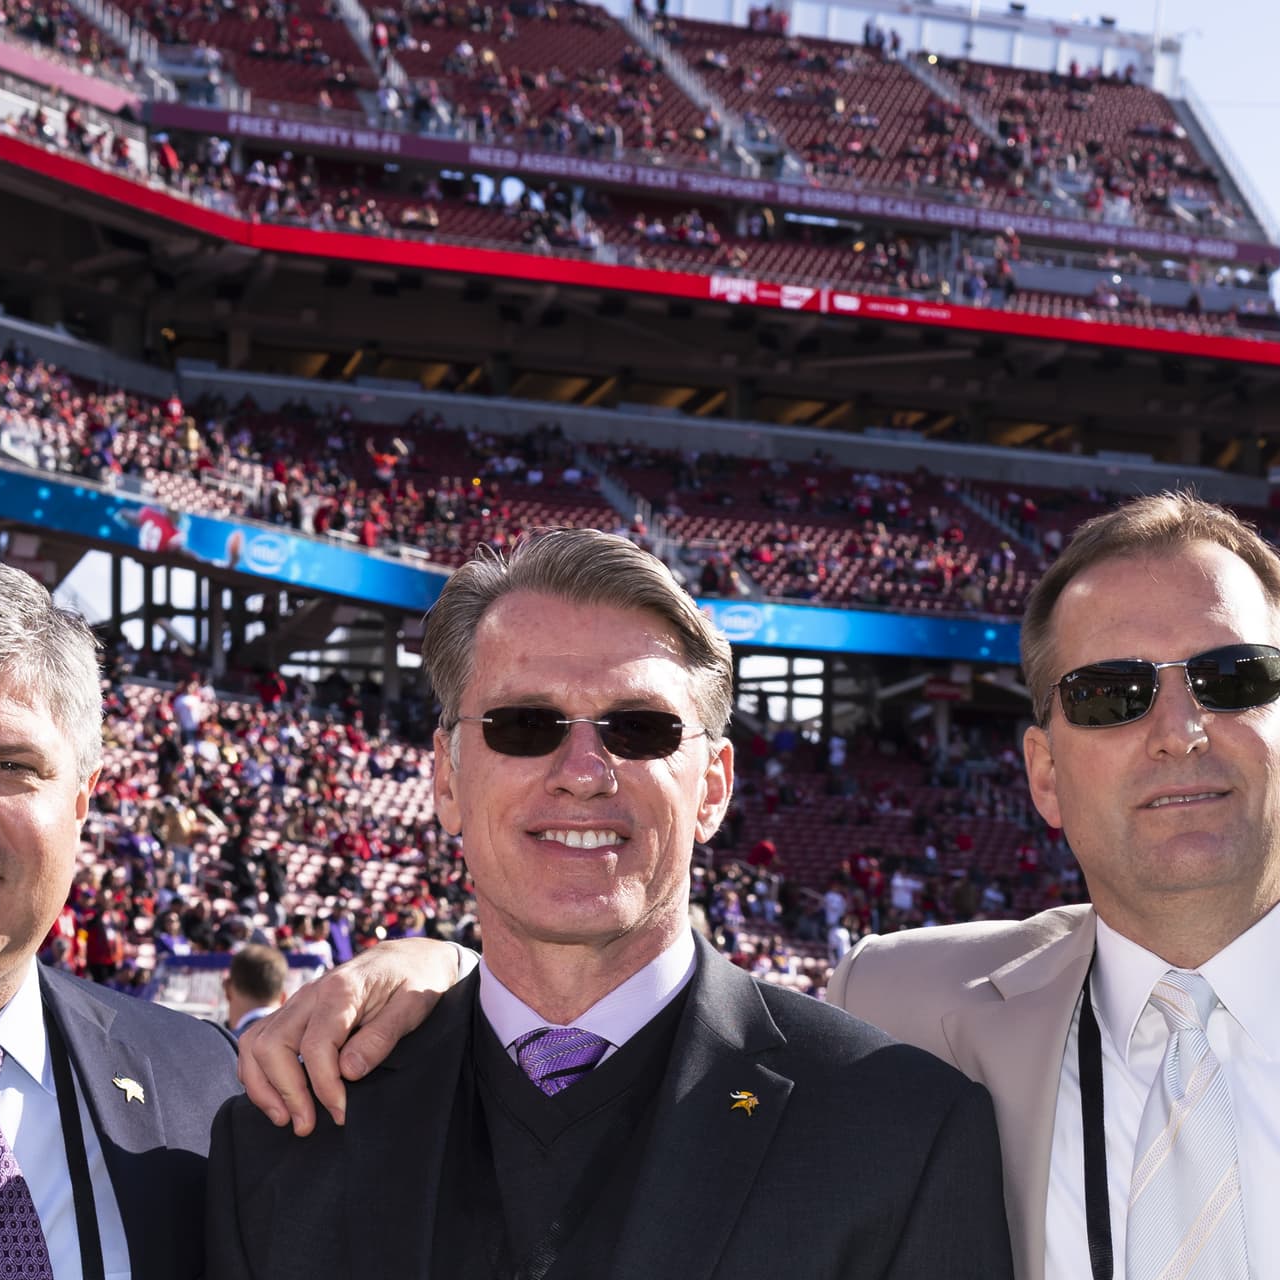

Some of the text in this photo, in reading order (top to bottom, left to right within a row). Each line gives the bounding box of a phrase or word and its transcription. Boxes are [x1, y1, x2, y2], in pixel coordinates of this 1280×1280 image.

[228, 115, 274, 136] FREE
[277, 121, 350, 147] XFINITY
[469, 146, 517, 167] NEED
